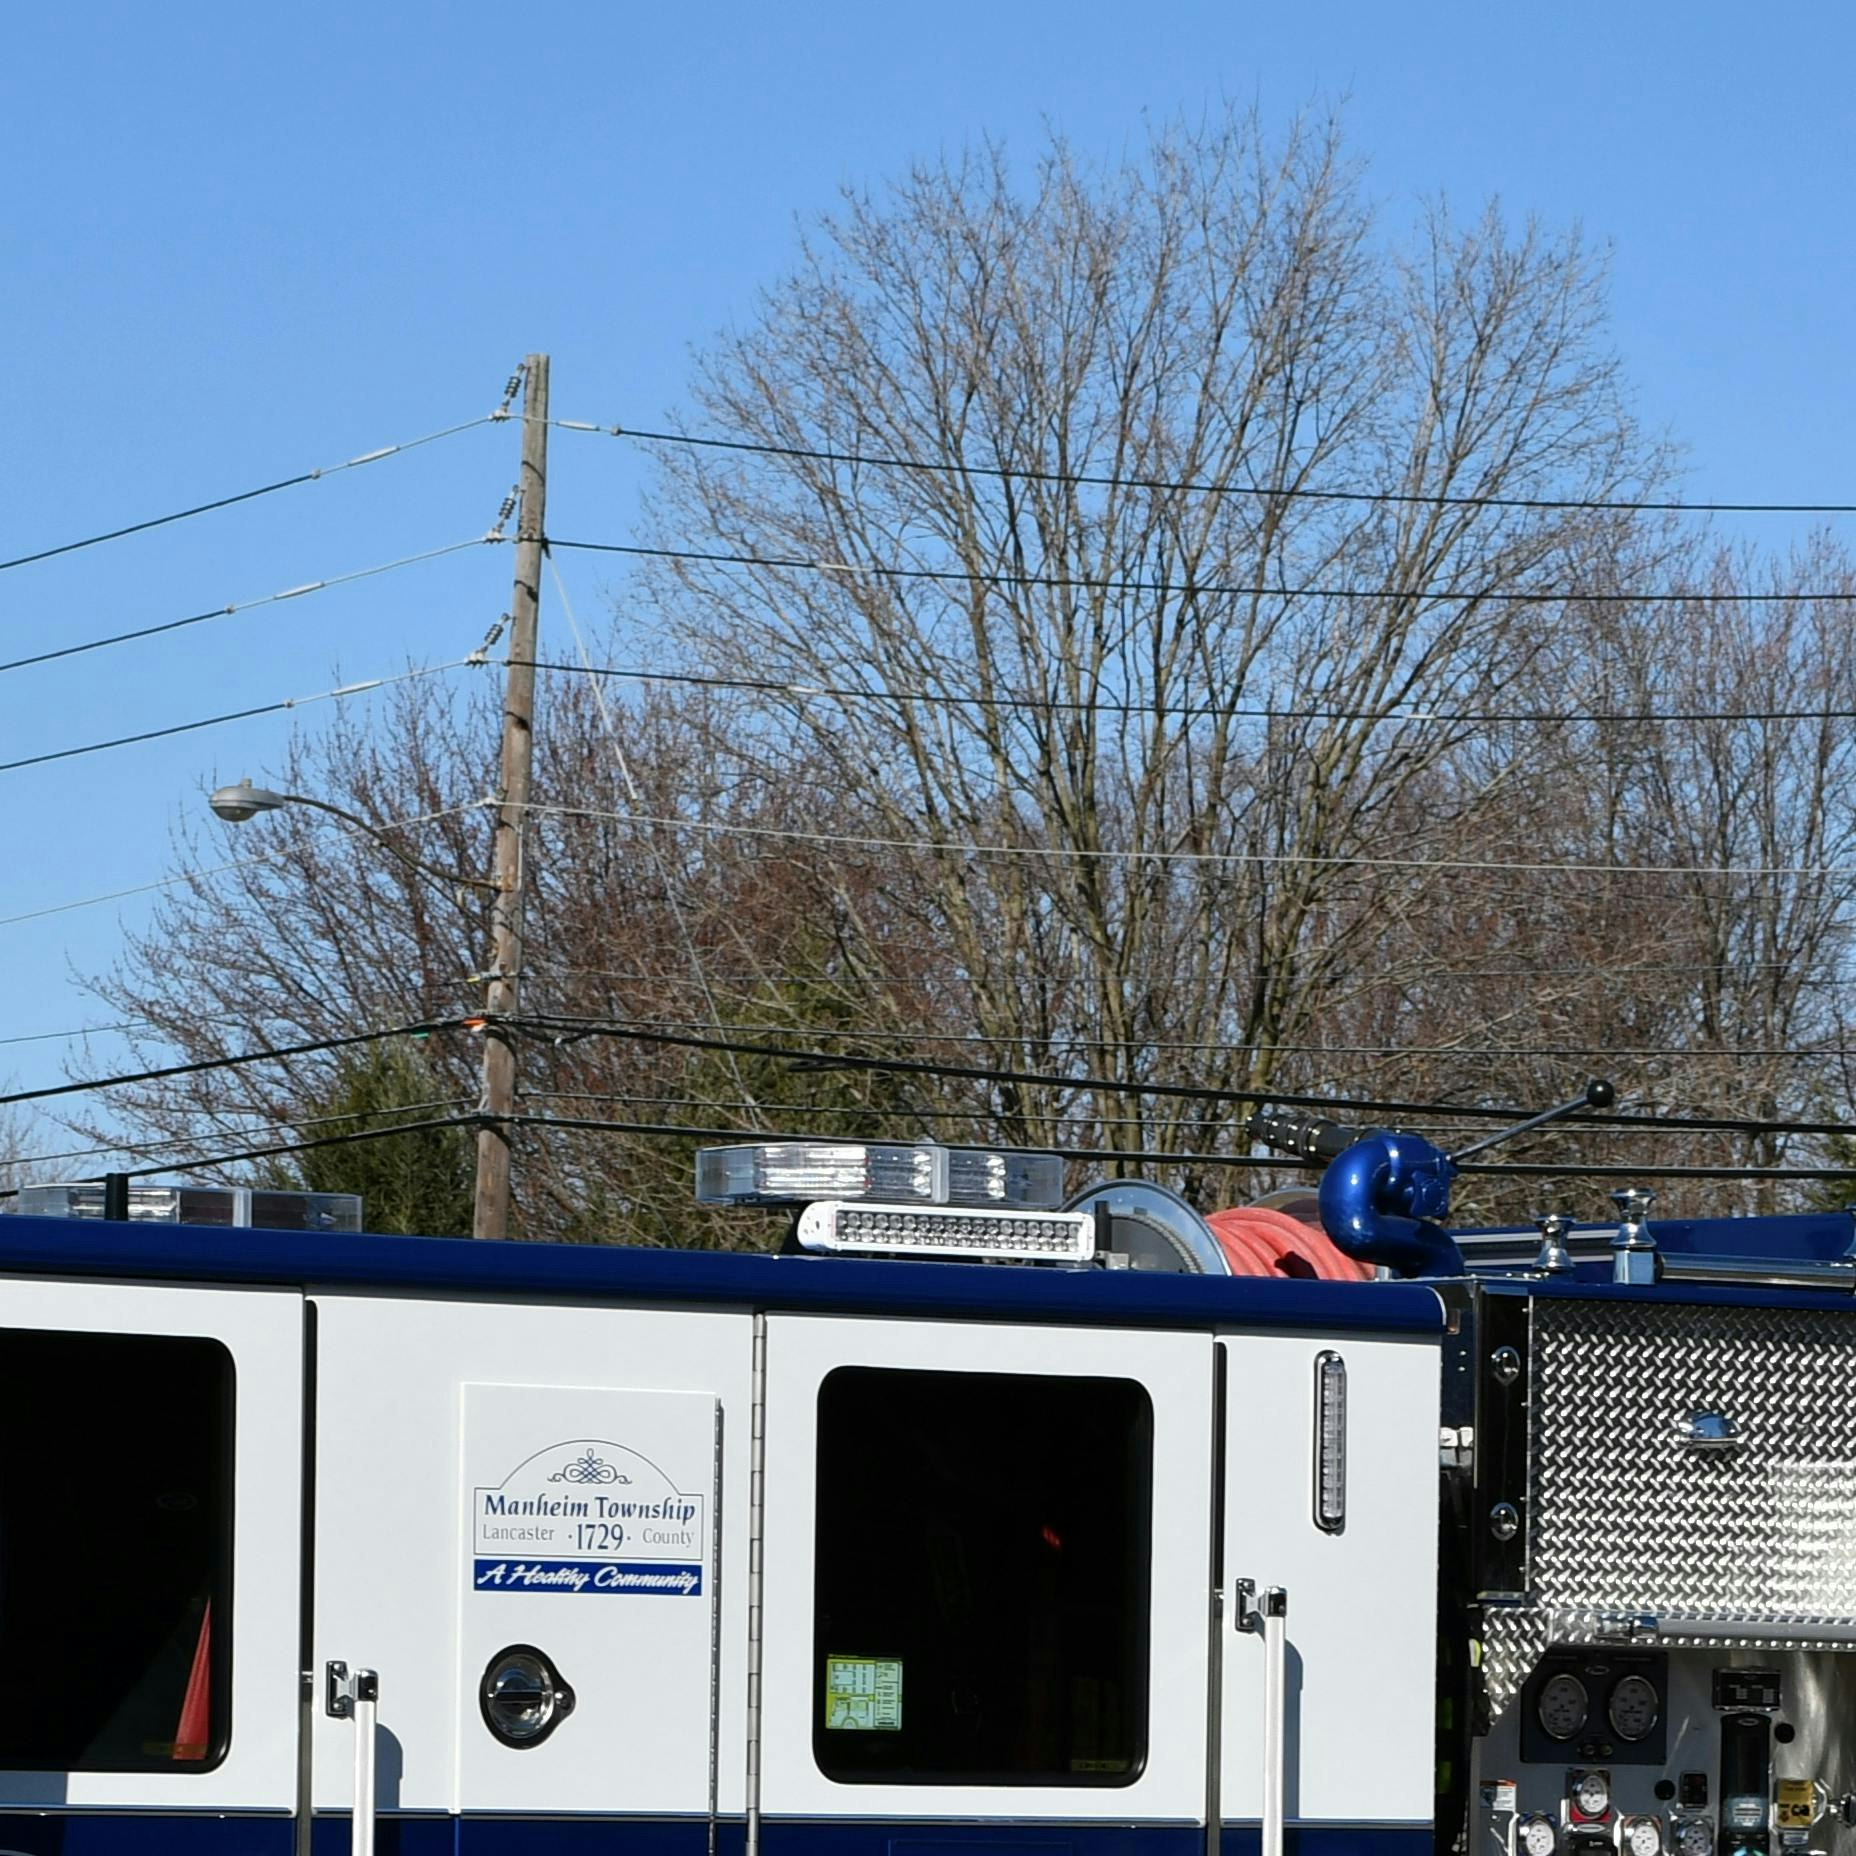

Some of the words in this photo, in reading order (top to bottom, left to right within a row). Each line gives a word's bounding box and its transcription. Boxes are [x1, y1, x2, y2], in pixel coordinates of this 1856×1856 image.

[484, 1493, 589, 1518] Manheim
[594, 1496, 695, 1526] Township
[482, 1523, 555, 1541] Lancaster
[642, 1529, 693, 1548] County
[477, 1563, 507, 1585] A
[506, 1565, 590, 1592] Healthy
[594, 1566, 699, 1595] Community
